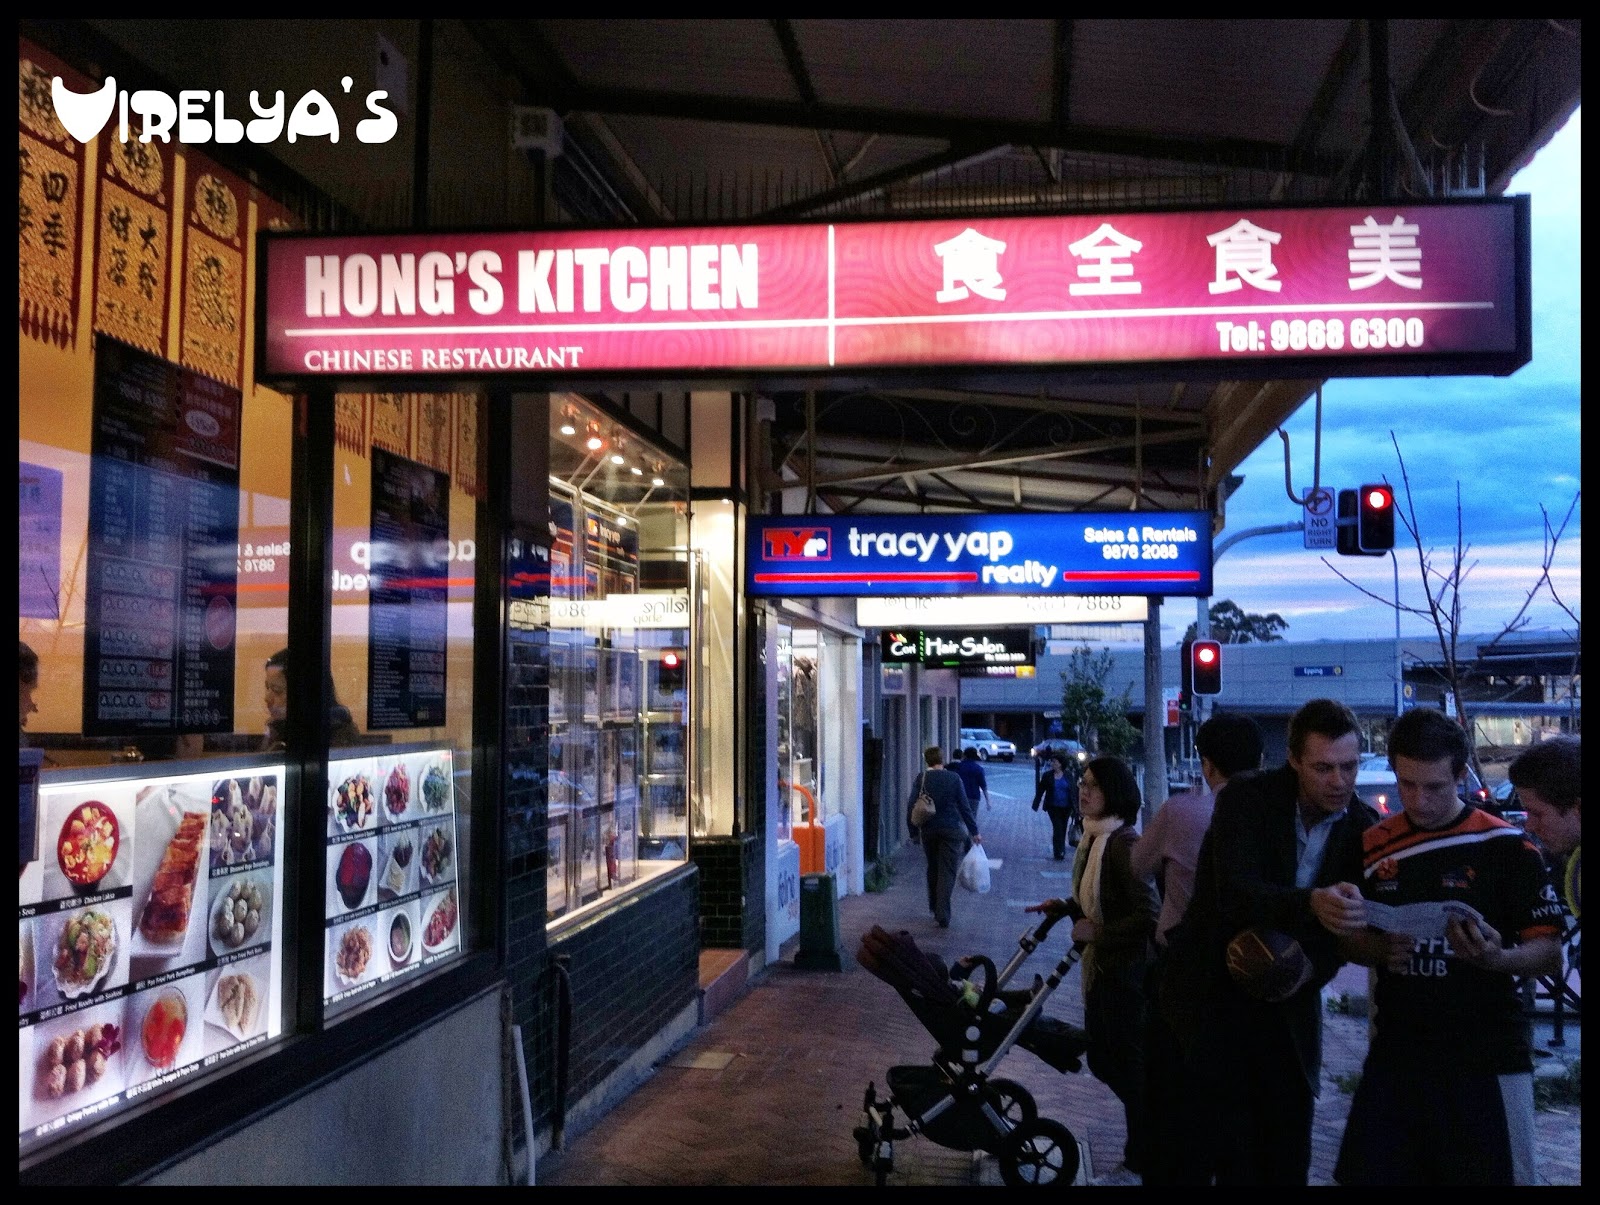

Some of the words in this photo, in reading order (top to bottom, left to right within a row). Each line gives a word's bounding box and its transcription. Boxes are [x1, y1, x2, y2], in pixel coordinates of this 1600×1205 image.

[933, 214, 1424, 304] 食全食美
[305, 250, 504, 319] HONG'S
[518, 243, 760, 315] KITCHEN
[1215, 323, 1266, 354] Tel:
[1270, 319, 1343, 352] 9868
[1349, 316, 1424, 350] 6300
[304, 349, 414, 372] CHINESE
[420, 345, 582, 371] RESTAURANT
[1083, 527, 1125, 542] Sales
[1127, 527, 1139, 542] &
[1142, 526, 1197, 542] Rentals
[1307, 528, 1332, 536] RIGHT
[1311, 518, 1328, 527] NO
[848, 527, 939, 562] tracy
[944, 530, 1012, 562] yap
[1308, 537, 1332, 545] TURN
[982, 561, 1057, 588] realty
[925, 637, 960, 656] Hair
[959, 636, 1005, 656] Salon
